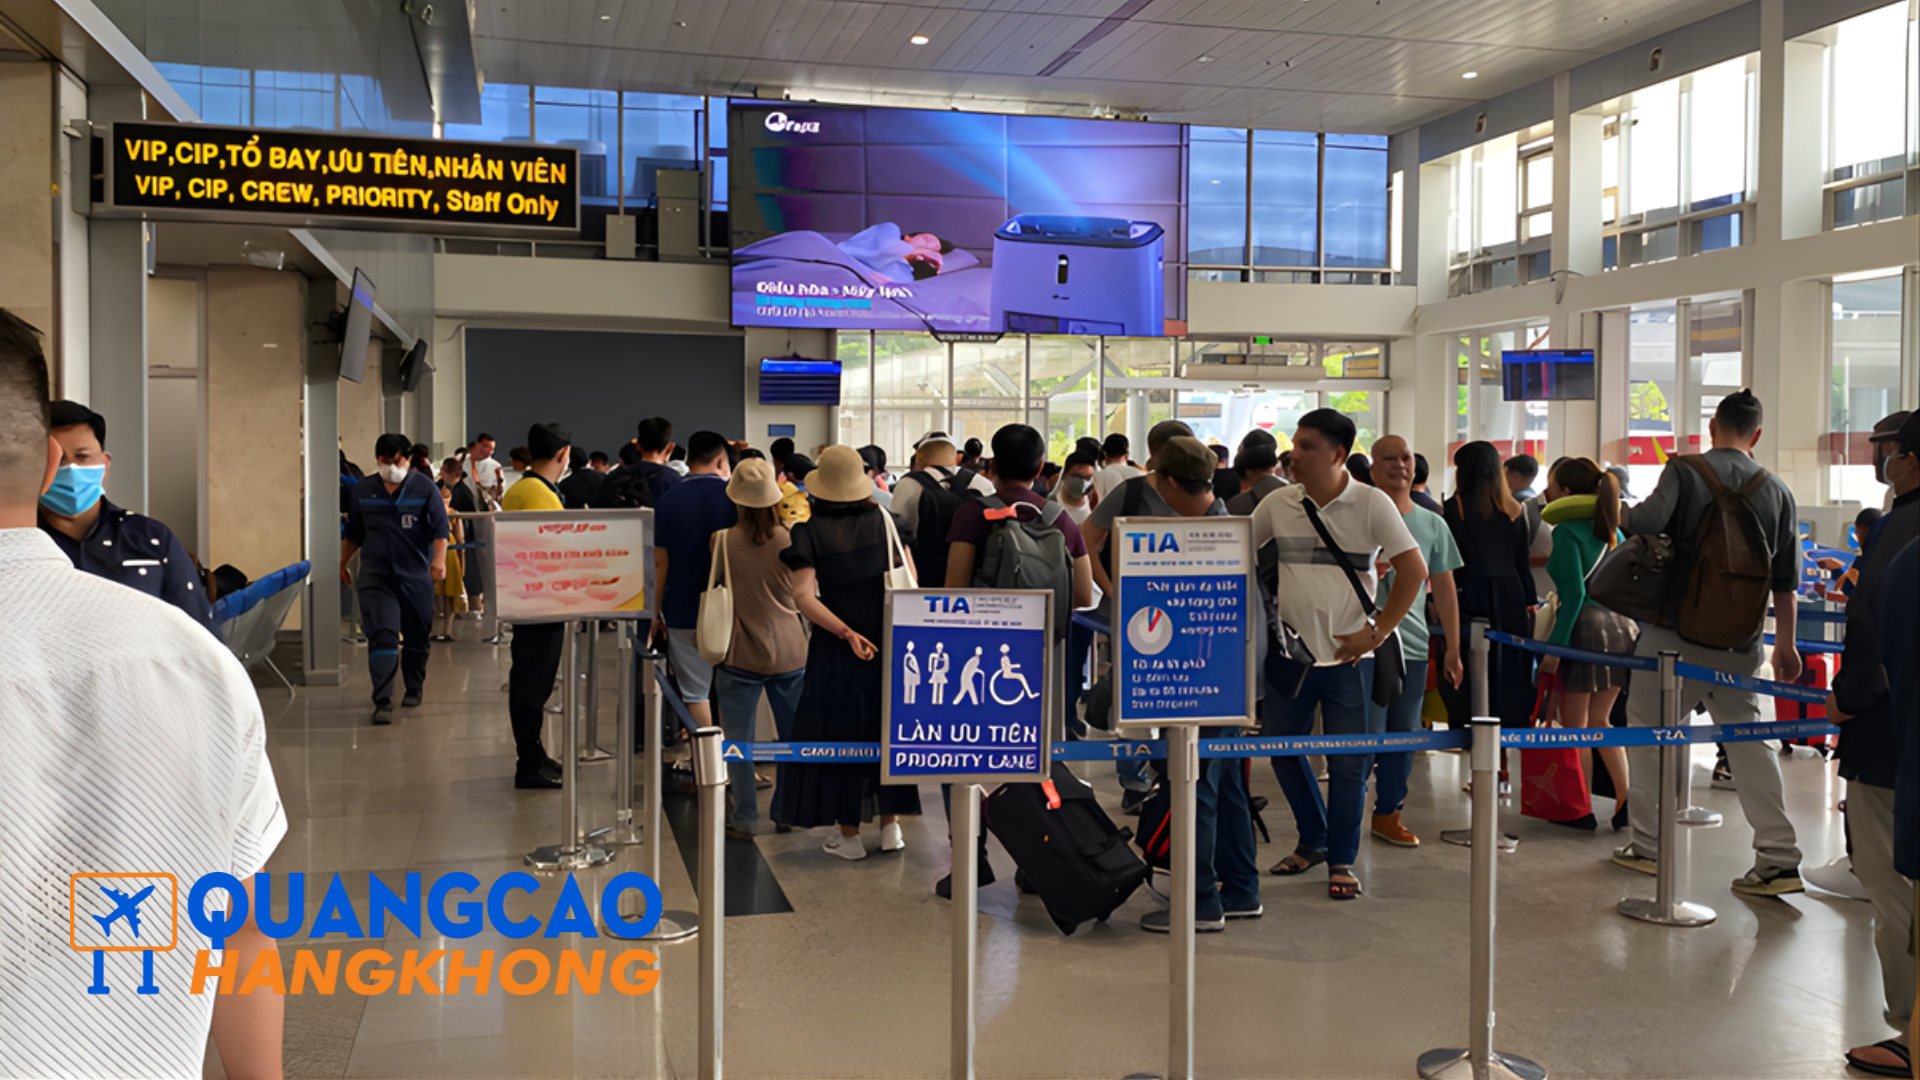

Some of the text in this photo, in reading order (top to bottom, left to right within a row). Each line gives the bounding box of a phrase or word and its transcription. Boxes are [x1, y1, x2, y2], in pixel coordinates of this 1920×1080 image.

[510, 156, 567, 184] VIÊN
[135, 174, 559, 222] VIP, CIP, CREW, PRIORITY, Staff Only
[1125, 532, 1180, 553] TIA
[923, 595, 970, 614] TIA
[898, 719, 942, 741] LÀN
[1108, 743, 1152, 758] TIA
